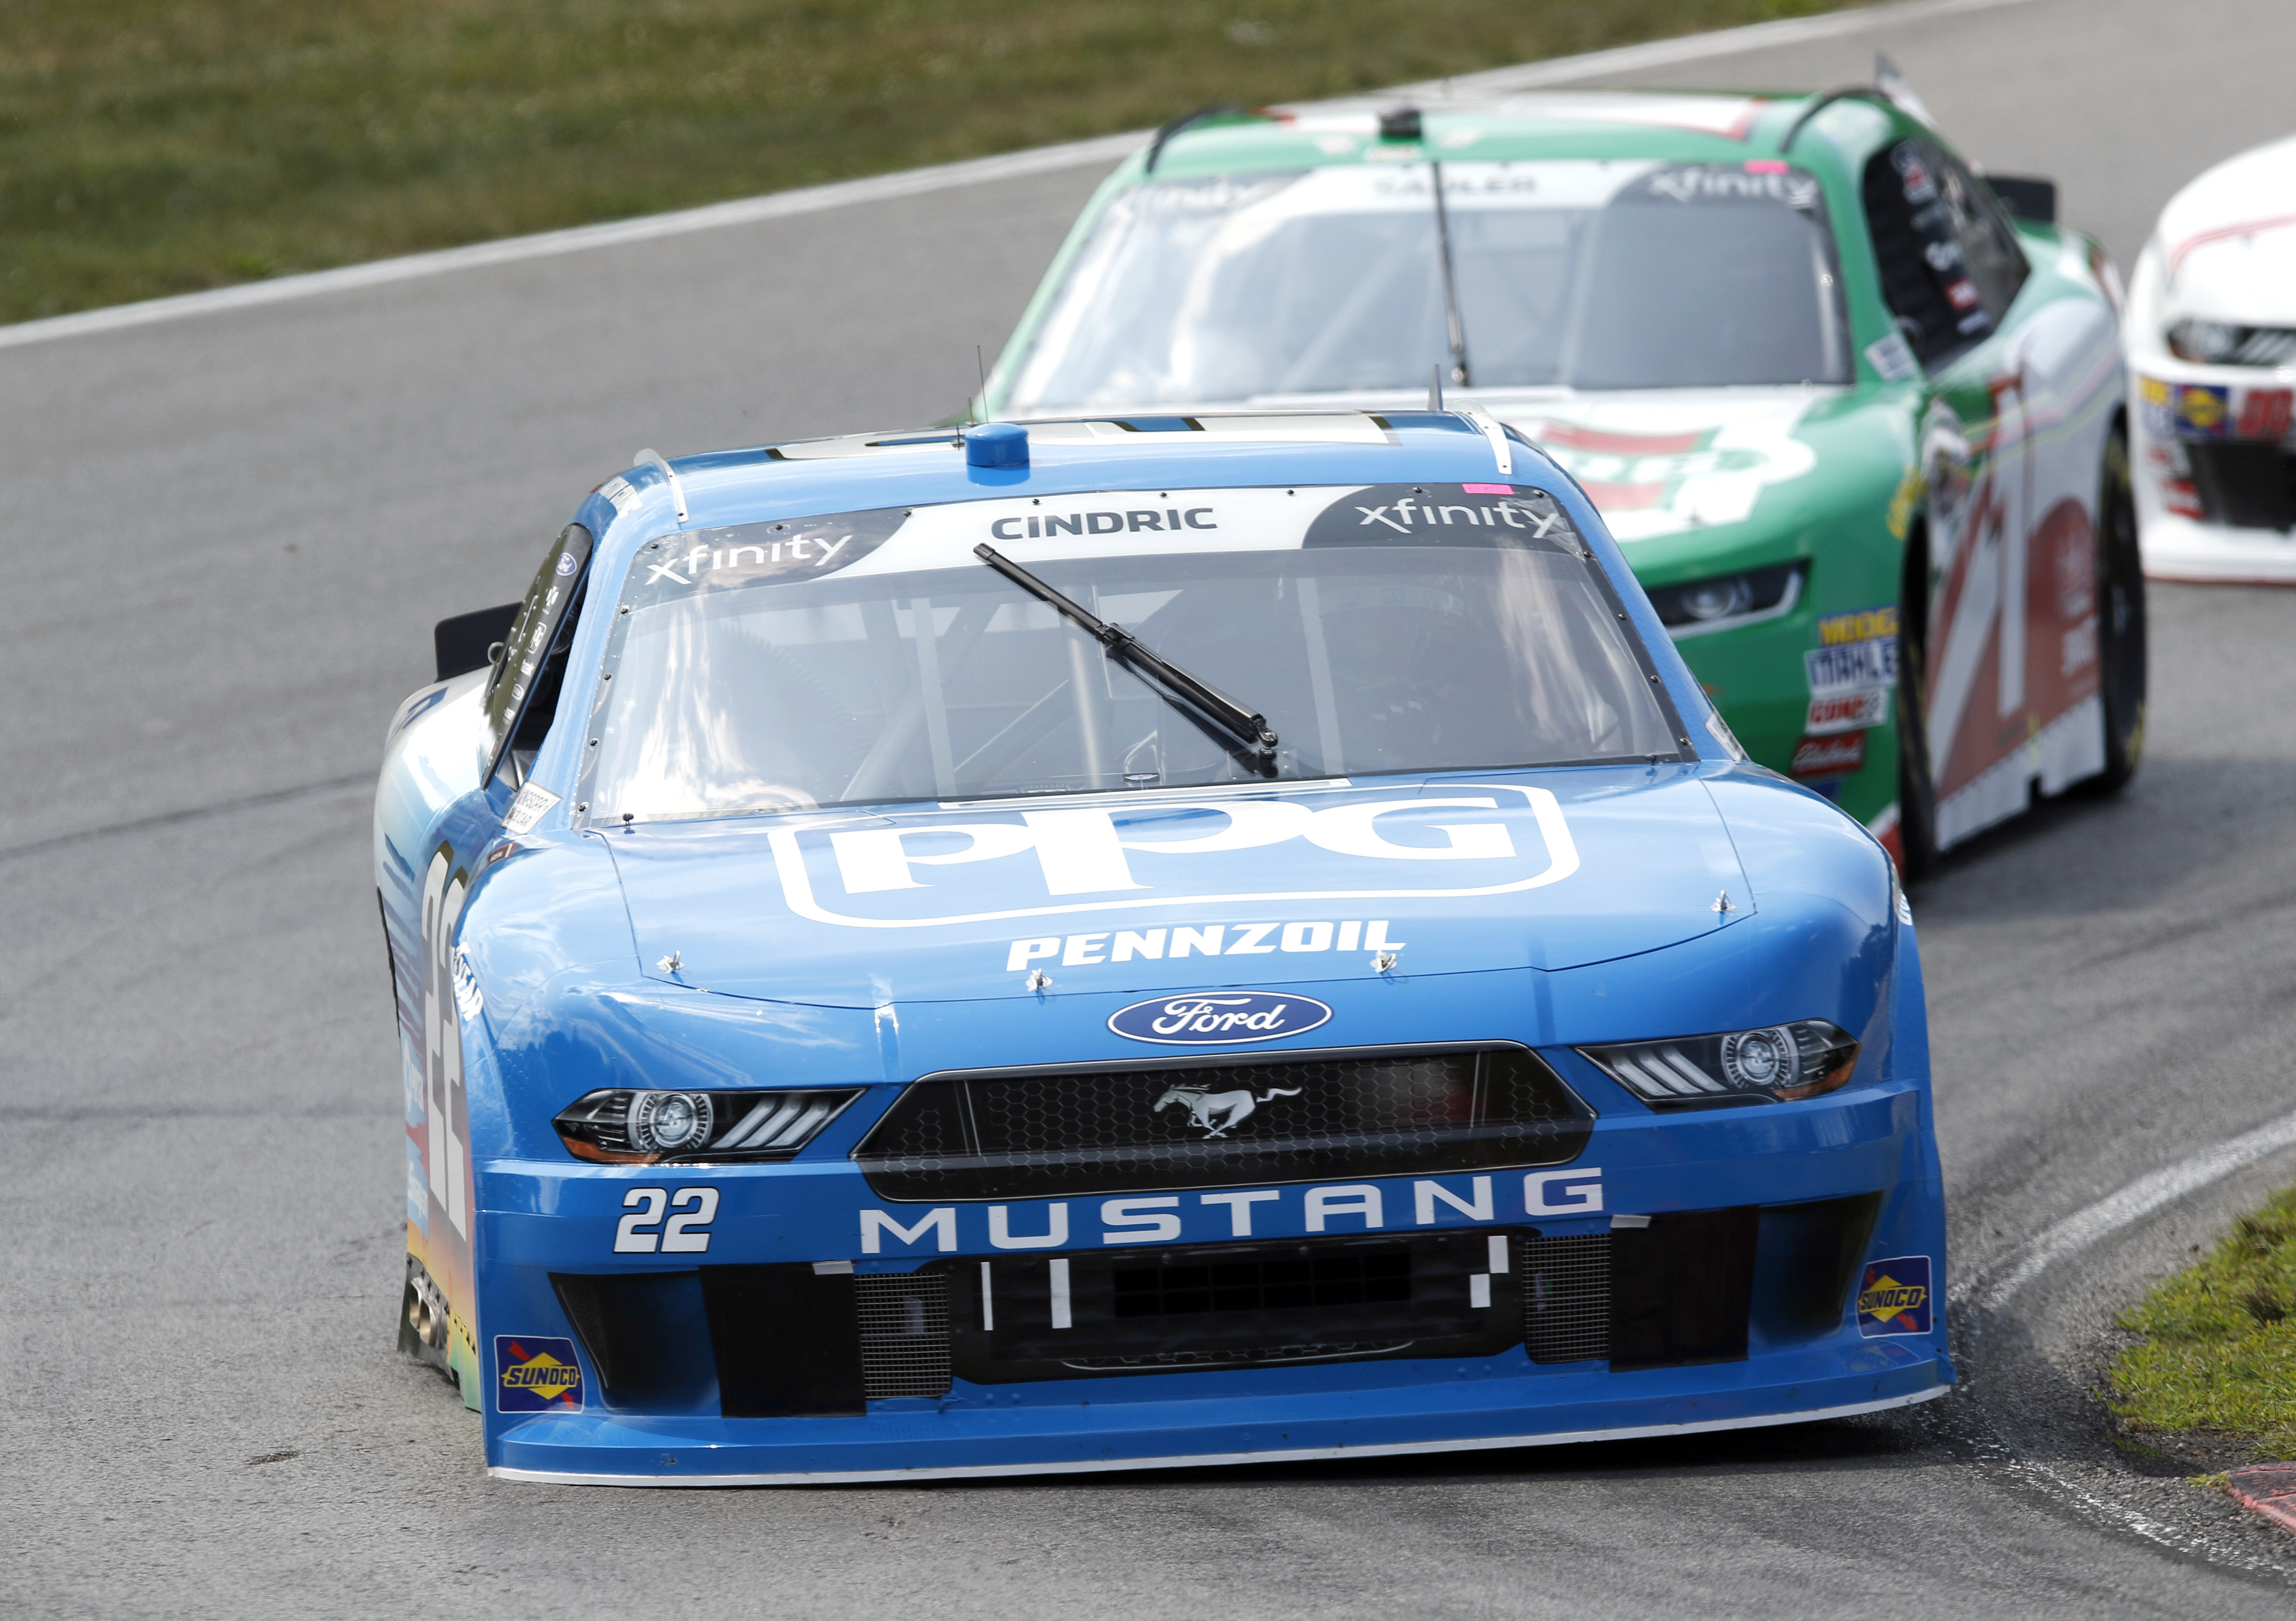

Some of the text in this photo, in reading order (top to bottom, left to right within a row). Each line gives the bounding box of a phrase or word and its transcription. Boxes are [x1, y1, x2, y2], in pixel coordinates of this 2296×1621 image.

[991, 508, 1217, 540] CINDRIC
[1354, 498, 1559, 538] xfinity
[644, 534, 853, 585] xfinity
[828, 800, 1517, 896] PPG
[1006, 920, 1407, 971] PENNZOIL
[1152, 998, 1286, 1034] Ford
[613, 1187, 719, 1253] 22
[859, 1168, 1603, 1253] MUSTANG
[1860, 1288, 1923, 1310] SUNOCO
[506, 1368, 576, 1385] SUNOCO
